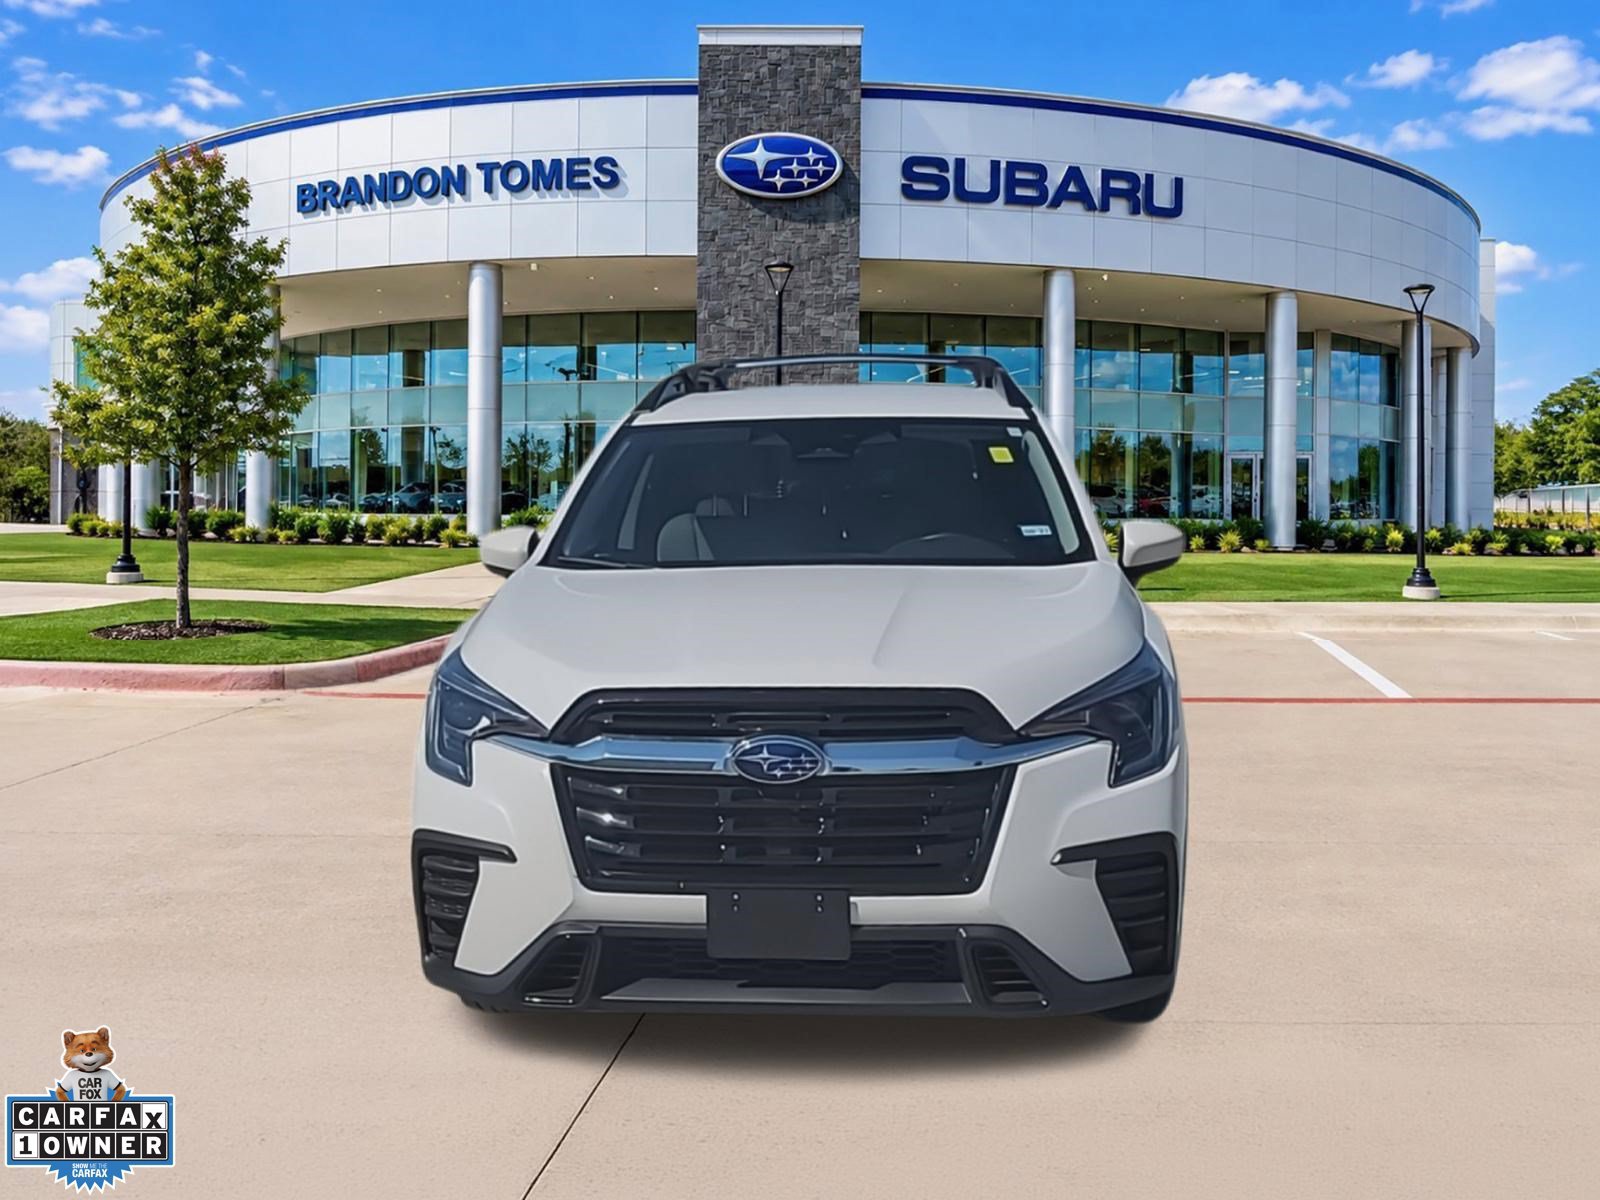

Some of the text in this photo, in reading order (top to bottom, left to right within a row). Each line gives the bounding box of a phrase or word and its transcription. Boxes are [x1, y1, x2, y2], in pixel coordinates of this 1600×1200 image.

[297, 156, 620, 214] BRANDON TOMES
[901, 155, 1184, 218] SUBARU
